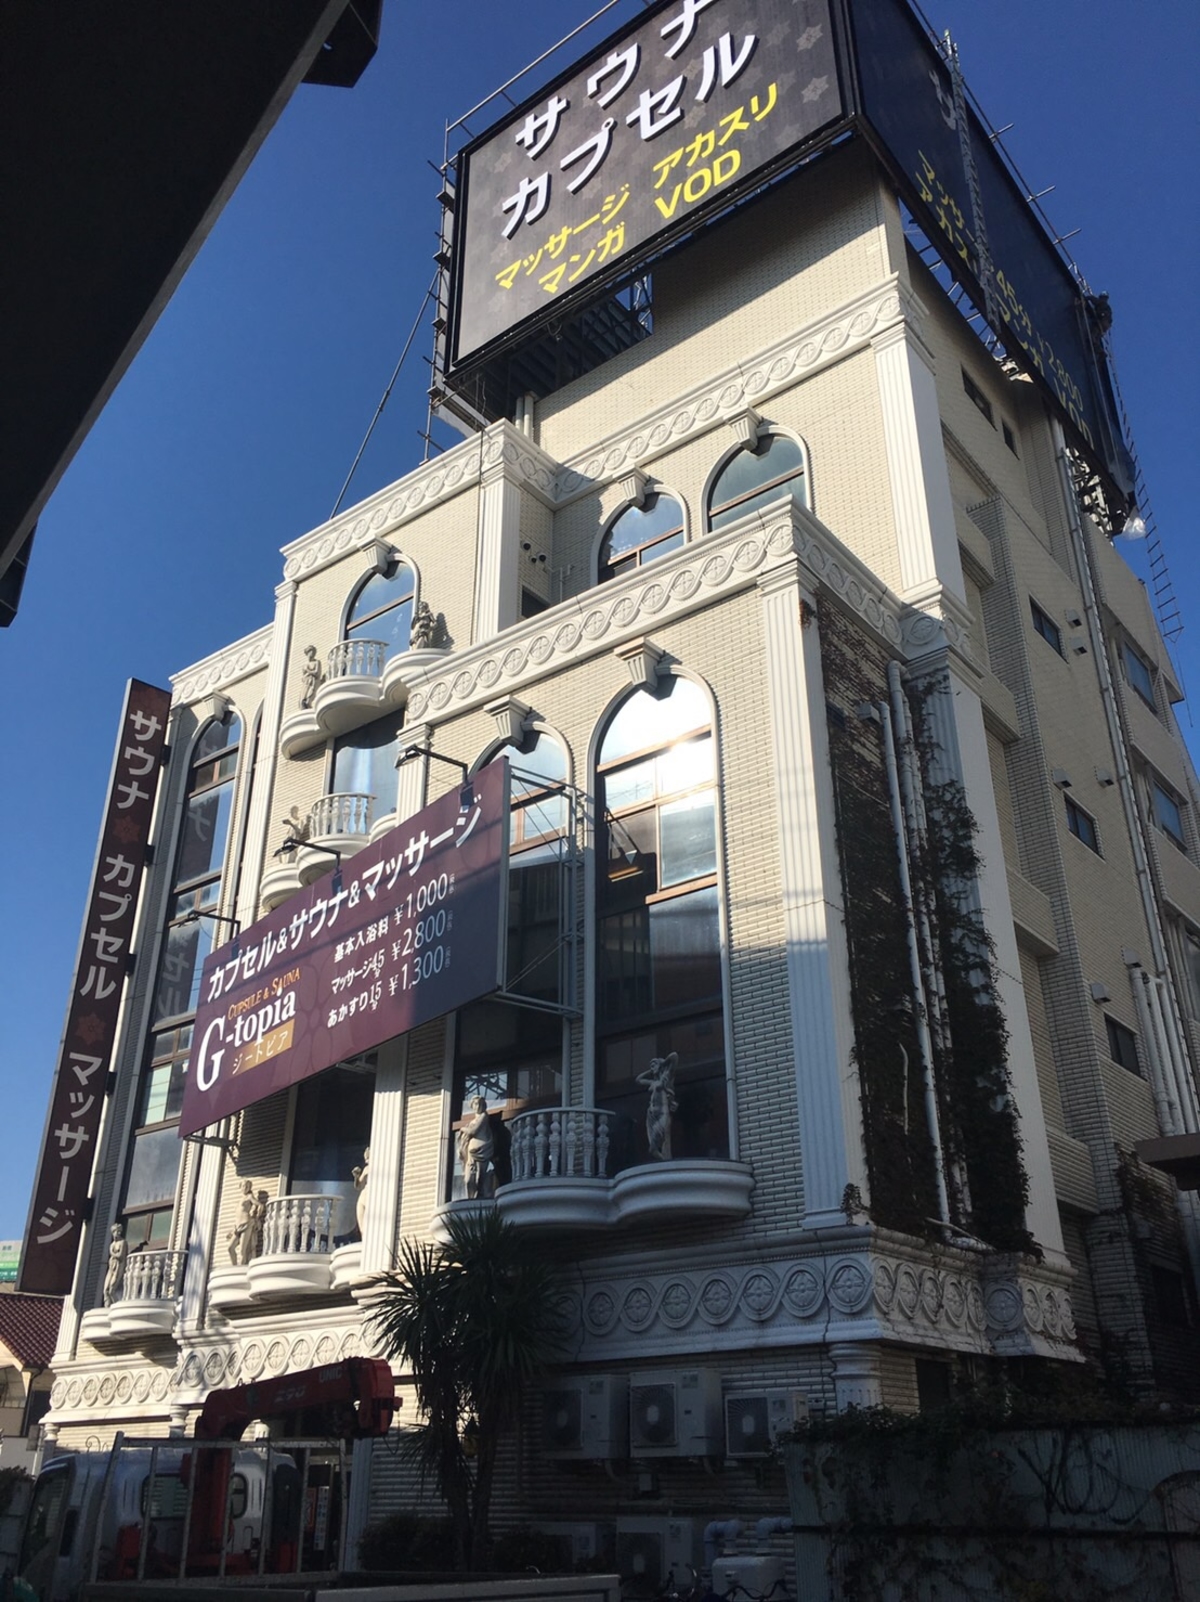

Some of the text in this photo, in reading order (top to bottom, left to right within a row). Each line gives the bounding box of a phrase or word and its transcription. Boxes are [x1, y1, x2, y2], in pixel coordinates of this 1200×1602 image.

[501, 32, 757, 239] カプセル
[495, 82, 778, 290] マッサージ アカスリ
[538, 149, 742, 294] マンガ VOD
[333, 915, 389, 964] 基本入浴料
[394, 873, 448, 926] ¥1,000
[391, 909, 446, 962] ¥2,800
[37, 710, 162, 1244] サウナ カプセル マッサージ
[271, 967, 301, 996] SAUNA
[388, 945, 444, 998] ¥1,300
[196, 986, 297, 1092] G-topia
[231, 1030, 289, 1075] ジートピア
[319, 1366, 343, 1383] UNIC
